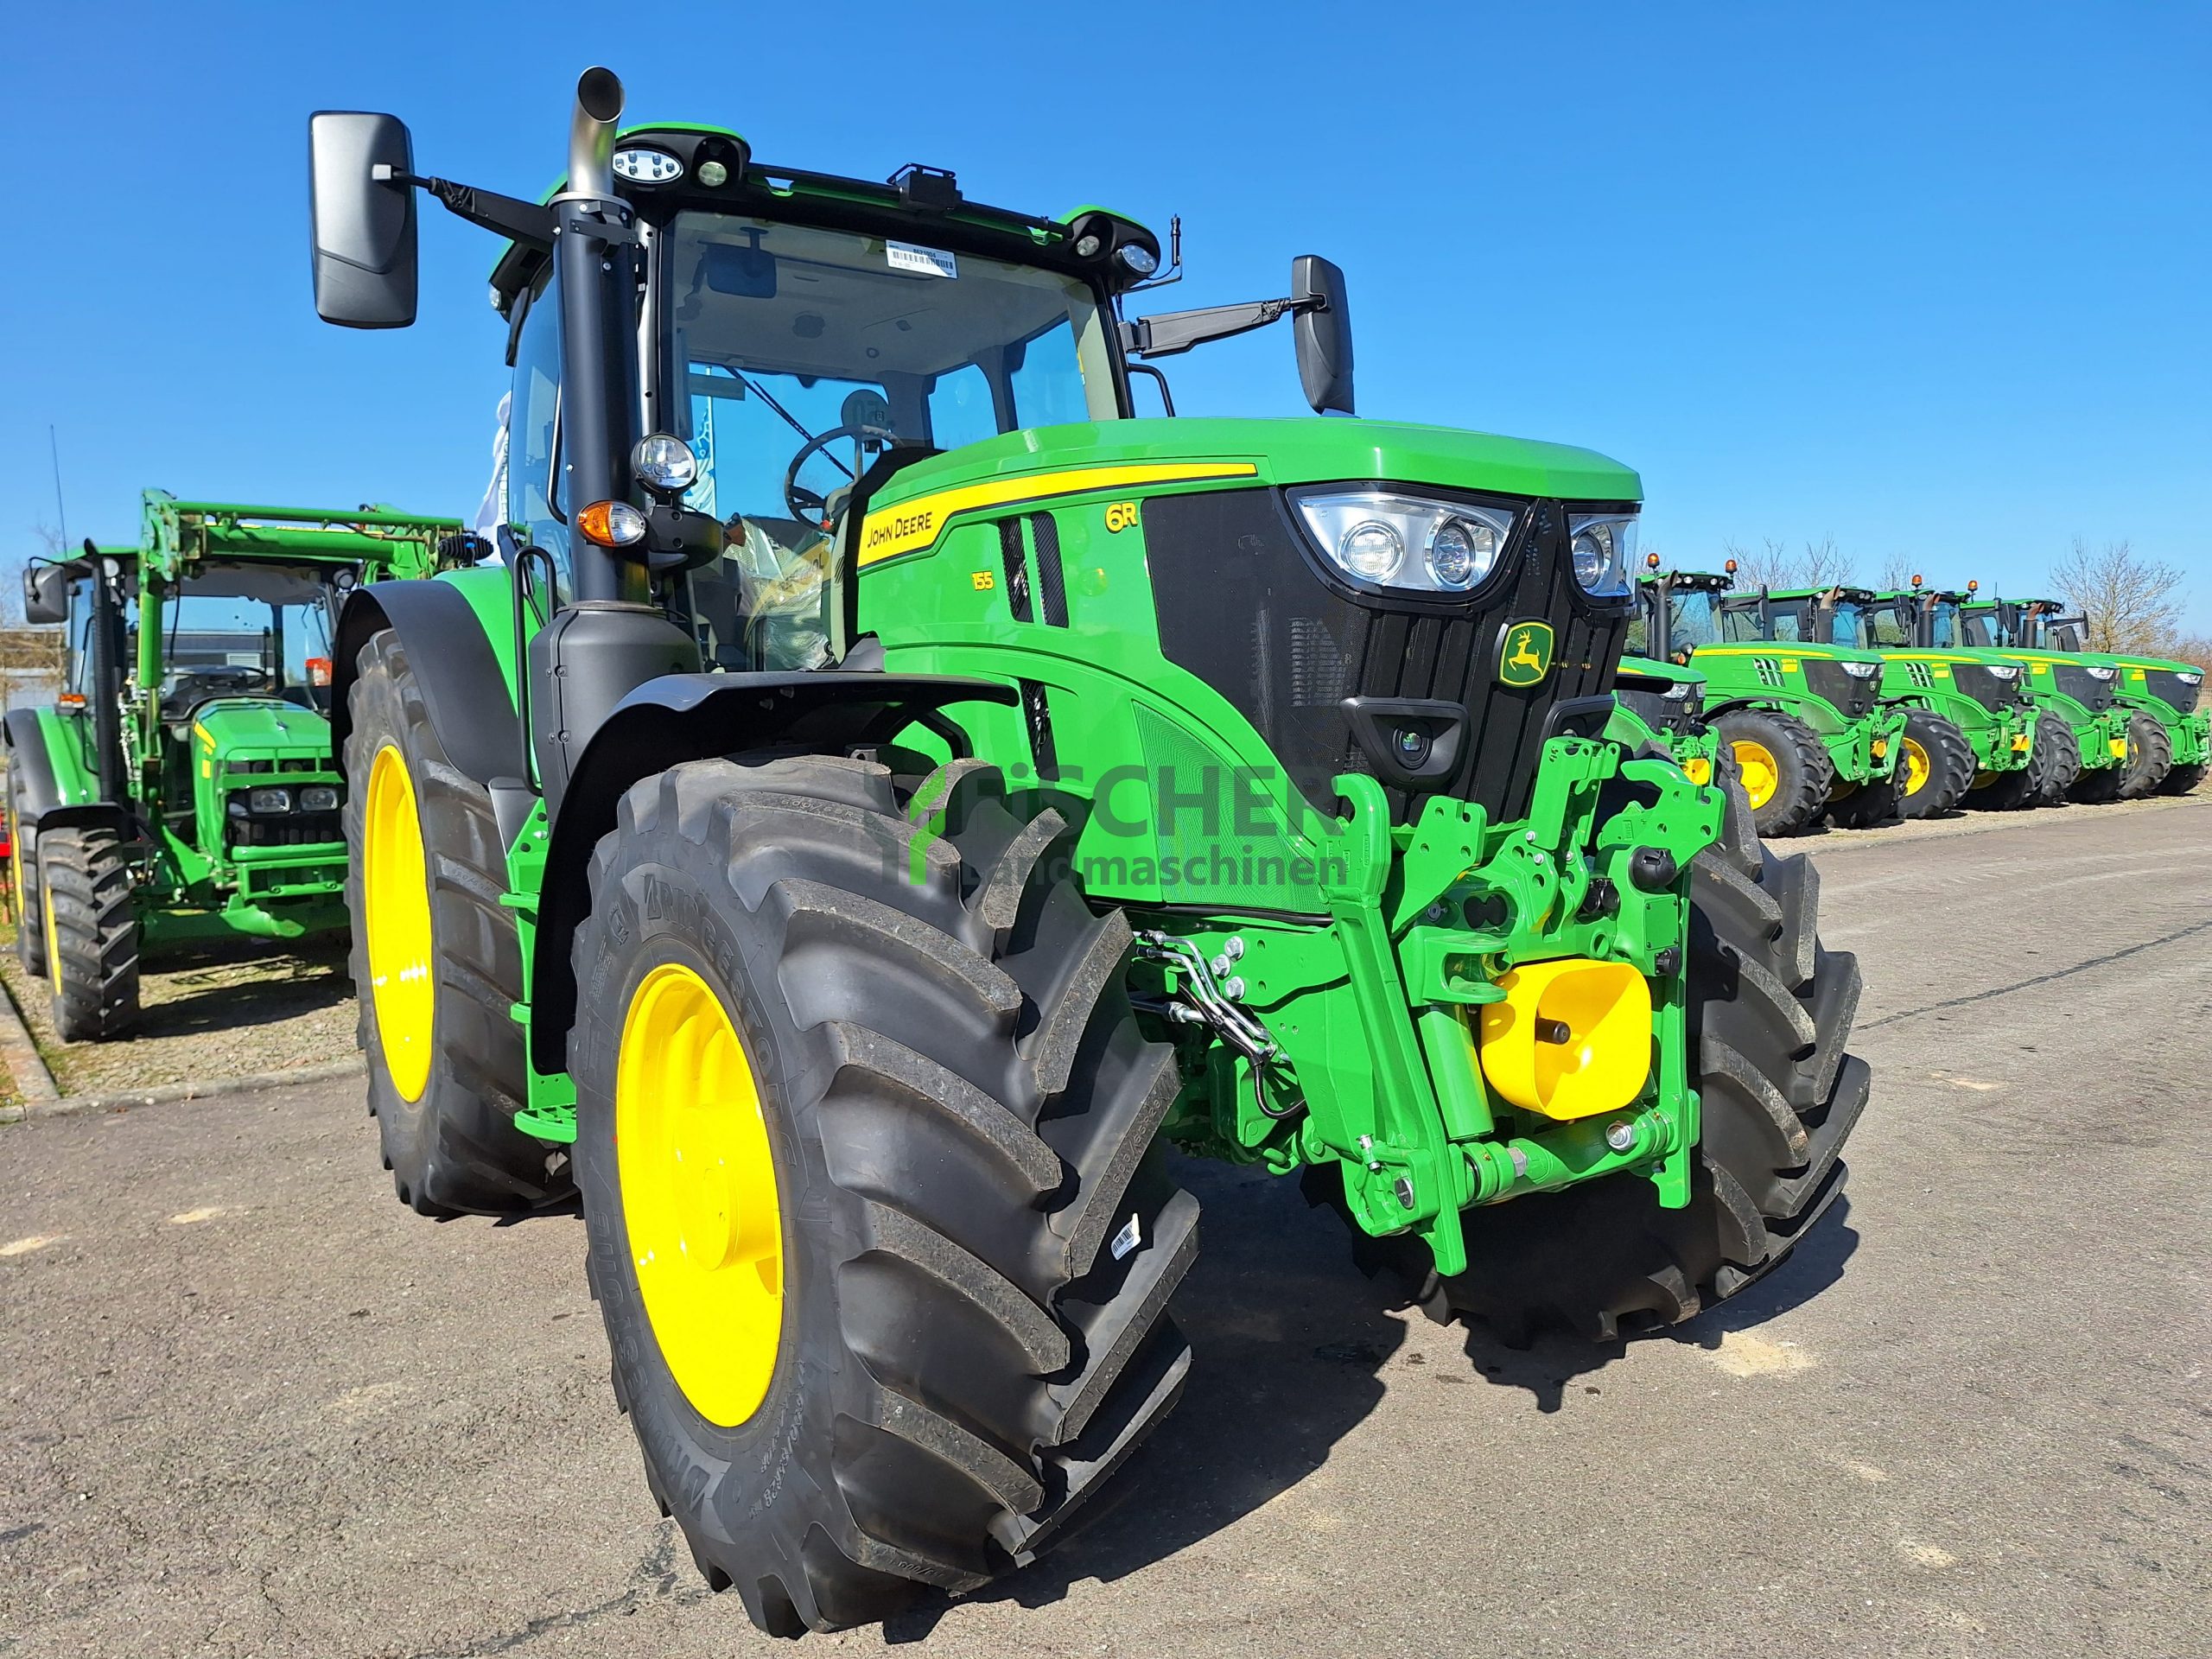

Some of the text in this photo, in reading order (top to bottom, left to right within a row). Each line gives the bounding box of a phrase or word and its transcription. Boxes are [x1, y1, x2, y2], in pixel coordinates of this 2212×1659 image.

[868, 512, 932, 548] JOHN DEERE
[1105, 502, 1137, 533] 6R
[971, 570, 994, 591] 155
